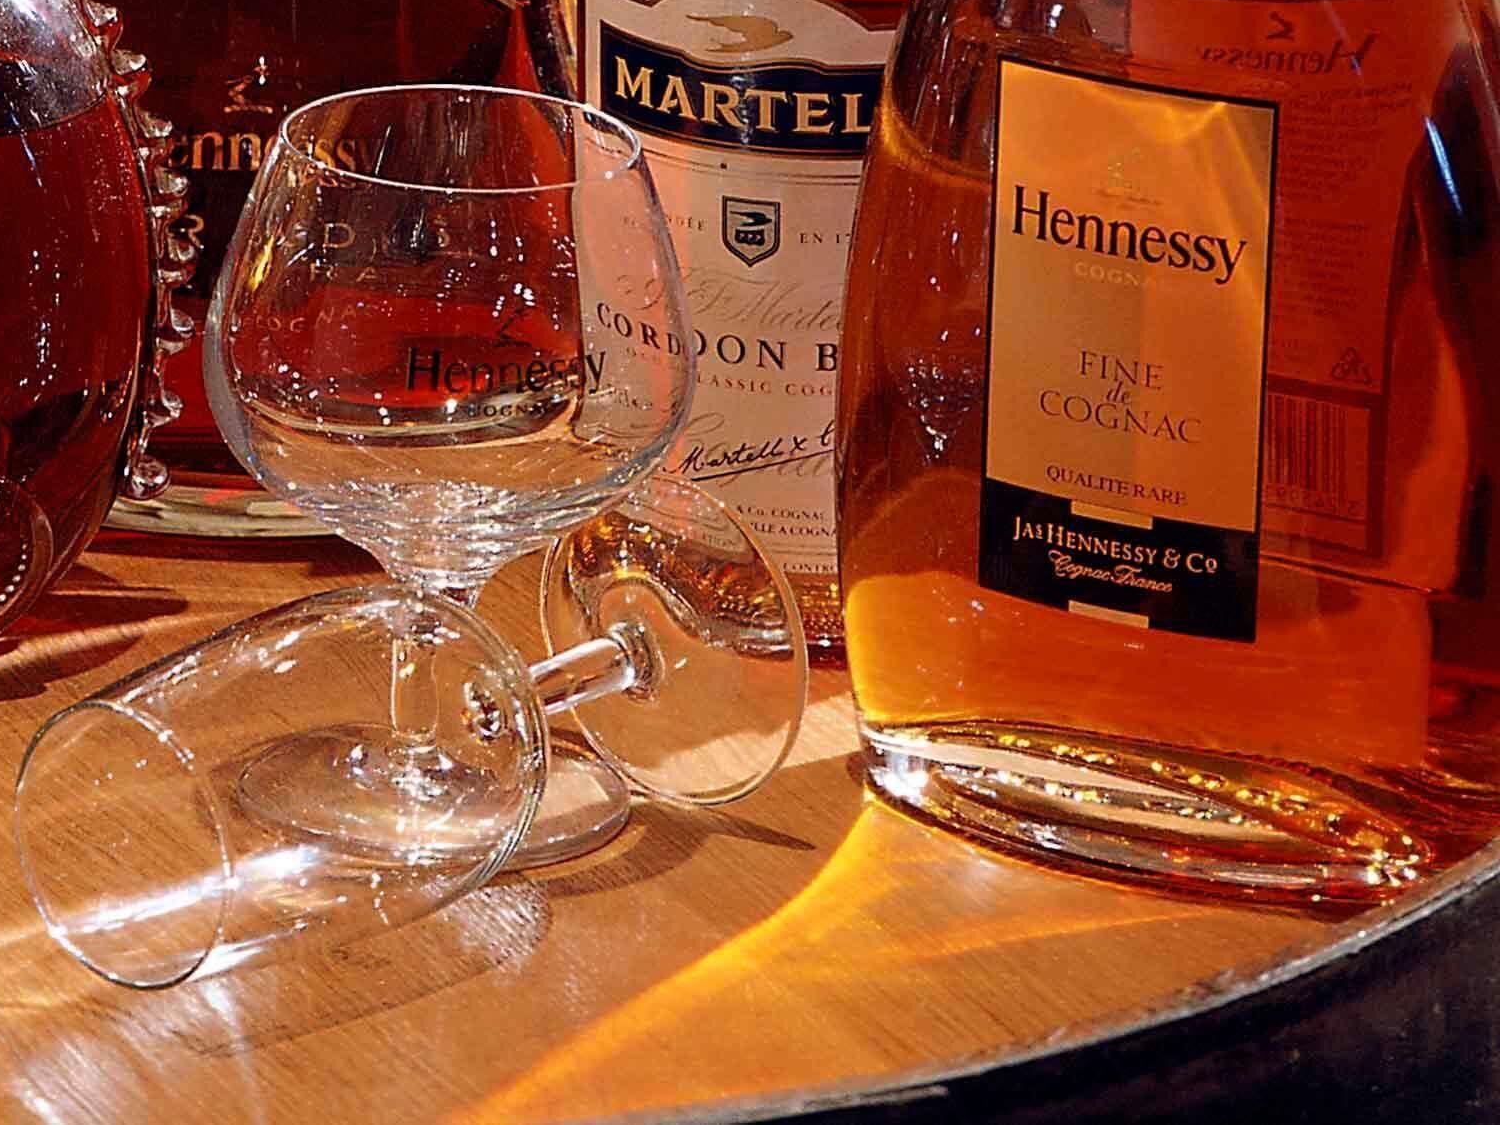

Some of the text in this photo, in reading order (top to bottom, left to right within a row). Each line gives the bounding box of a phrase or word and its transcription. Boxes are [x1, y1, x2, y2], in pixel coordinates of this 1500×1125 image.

[800, 232, 824, 244] EN
[1012, 185, 1248, 285] Hennessy
[596, 302, 787, 371] CORDON
[1079, 350, 1165, 391] FINE
[1105, 380, 1131, 406] de
[1039, 389, 1202, 444] COGNAC
[1045, 463, 1187, 506] QUALITE RARE
[1045, 523, 1158, 567] HENNESSY
[1162, 547, 1181, 570] &
